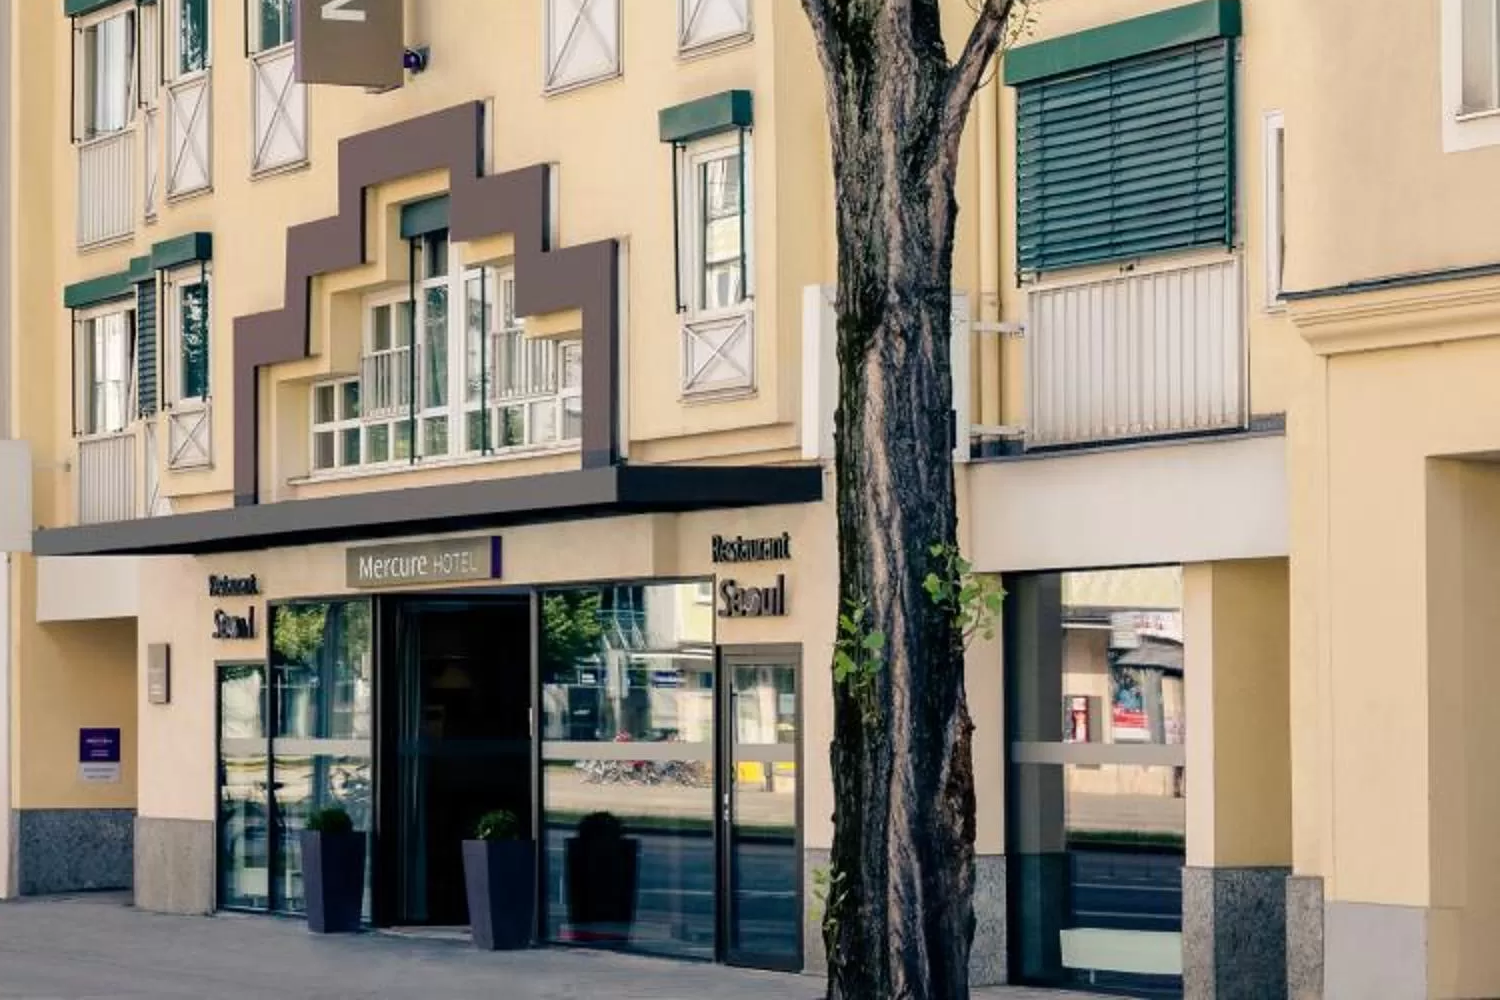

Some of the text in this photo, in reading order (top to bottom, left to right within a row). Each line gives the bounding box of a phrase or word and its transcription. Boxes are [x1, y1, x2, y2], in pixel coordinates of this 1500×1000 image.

[712, 532, 791, 563] Restaurant
[359, 551, 477, 580] Mercure HOTEL
[718, 574, 785, 616] Seoul
